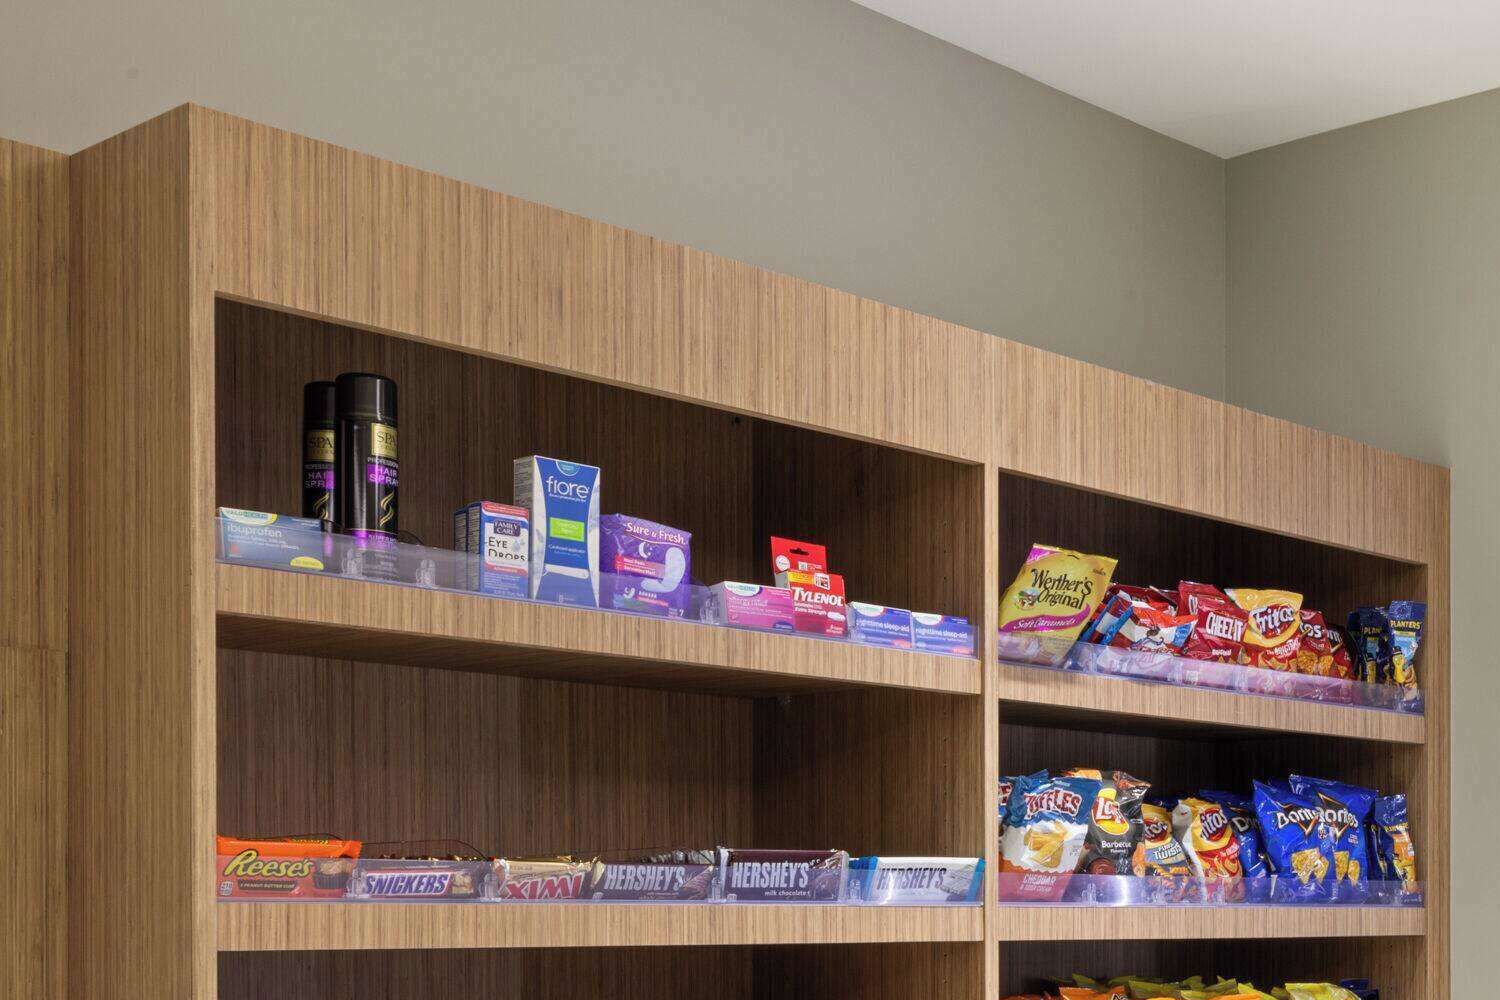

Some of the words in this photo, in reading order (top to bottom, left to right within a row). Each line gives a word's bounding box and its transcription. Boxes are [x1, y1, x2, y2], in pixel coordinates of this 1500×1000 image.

[309, 437, 333, 449] SPA
[227, 524, 282, 538] ibuprofen
[494, 521, 518, 531] FAMILY
[496, 528, 515, 536] CARE
[626, 522, 651, 536] Sure
[658, 530, 684, 544] Fresh
[488, 537, 508, 549] EYE
[488, 549, 527, 562] DROPS
[1031, 568, 1094, 596] Werther's
[791, 586, 844, 607] TYLENOL
[1037, 589, 1086, 610] Original
[1013, 618, 1034, 630] Soft
[1034, 615, 1077, 628] Caramels
[1205, 611, 1245, 642] CHEEZ-IT
[1250, 604, 1295, 635] Fritos
[1390, 619, 1422, 630] PLANTERS
[1024, 788, 1082, 819] RUFFLES
[1096, 797, 1126, 825] Lay's
[224, 849, 313, 878] Reese's
[365, 873, 449, 895] SNICKERS
[604, 864, 685, 891] HERSHEY'S
[731, 861, 811, 888] HERSHEY'S
[877, 867, 947, 890] HERSHEY'S
[764, 889, 777, 897] milk
[778, 889, 806, 897] chocolate
